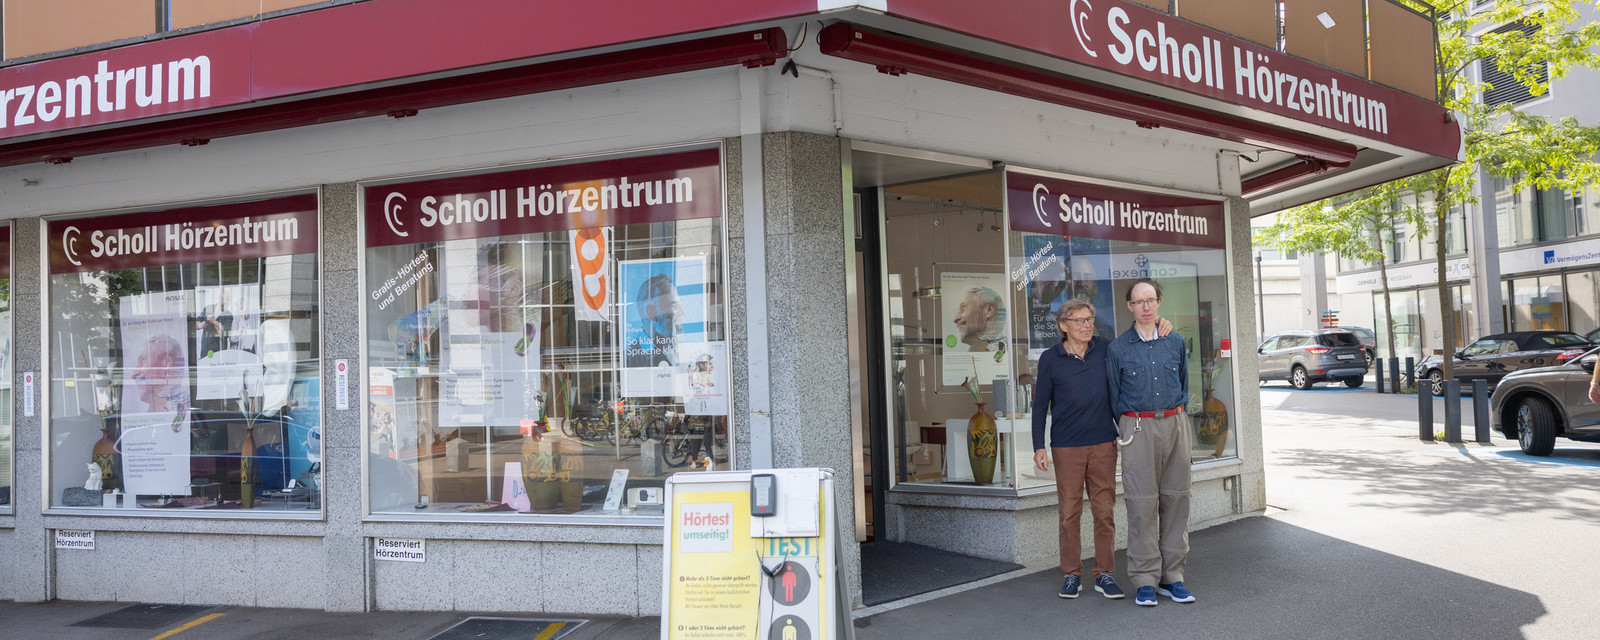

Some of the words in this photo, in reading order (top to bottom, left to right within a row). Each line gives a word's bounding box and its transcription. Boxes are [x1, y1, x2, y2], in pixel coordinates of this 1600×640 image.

[1107, 5, 1223, 90] Scholl
[1233, 45, 1388, 134] Hörzentrum
[0, 55, 211, 129] rzentrum
[420, 188, 507, 227] Scholl
[517, 176, 694, 218] Hörzentrum
[1059, 193, 1115, 227] Scholl
[1120, 201, 1208, 236] Hörzentrum
[90, 225, 158, 258] Scholl
[165, 216, 299, 250] Hörzentrum
[1011, 241, 1053, 281] Gratis-Hörtest
[371, 249, 429, 301] Gratis-Hörtest
[1016, 280, 1029, 291] und
[1028, 253, 1057, 280] Beratung
[378, 294, 395, 310] und
[394, 262, 433, 296] Beratung
[1033, 314, 1044, 322] Für
[1033, 322, 1045, 331] die
[626, 336, 637, 346] So
[639, 335, 654, 345] klar
[626, 347, 661, 358] Sprache
[683, 512, 730, 527] Hörtest
[56, 538, 94, 547] Hörzentrum
[58, 530, 92, 538] Reserviert
[683, 529, 729, 542] umseitig!
[378, 538, 421, 549] Reserviert
[770, 537, 810, 557] TEST
[376, 549, 424, 559] Hörzentrum
